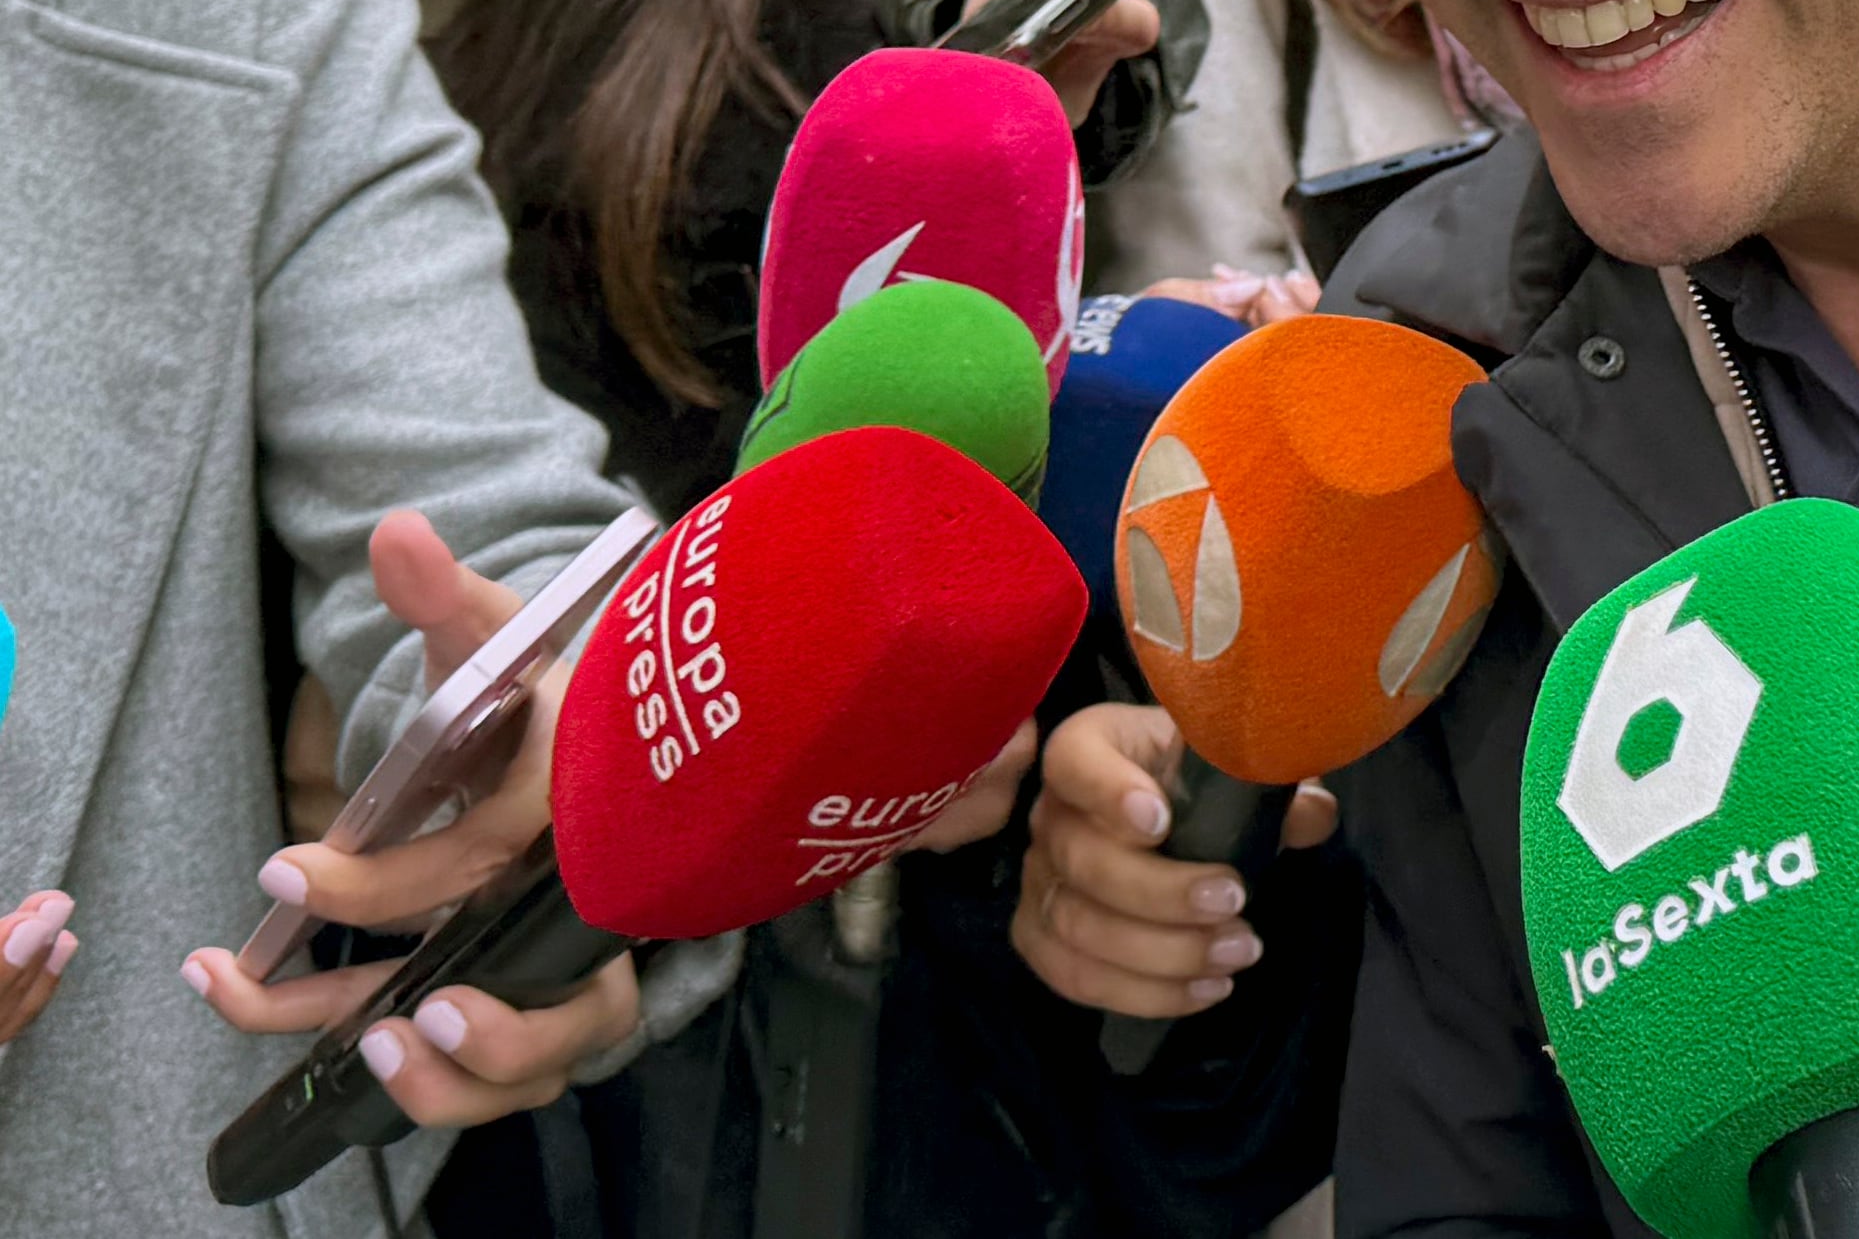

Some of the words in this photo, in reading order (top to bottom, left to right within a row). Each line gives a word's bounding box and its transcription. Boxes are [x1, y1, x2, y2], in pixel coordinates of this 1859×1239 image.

[623, 570, 683, 783] press
[678, 494, 741, 741] europa
[807, 768, 982, 828] euro
[1562, 832, 1819, 1009] laSexta
